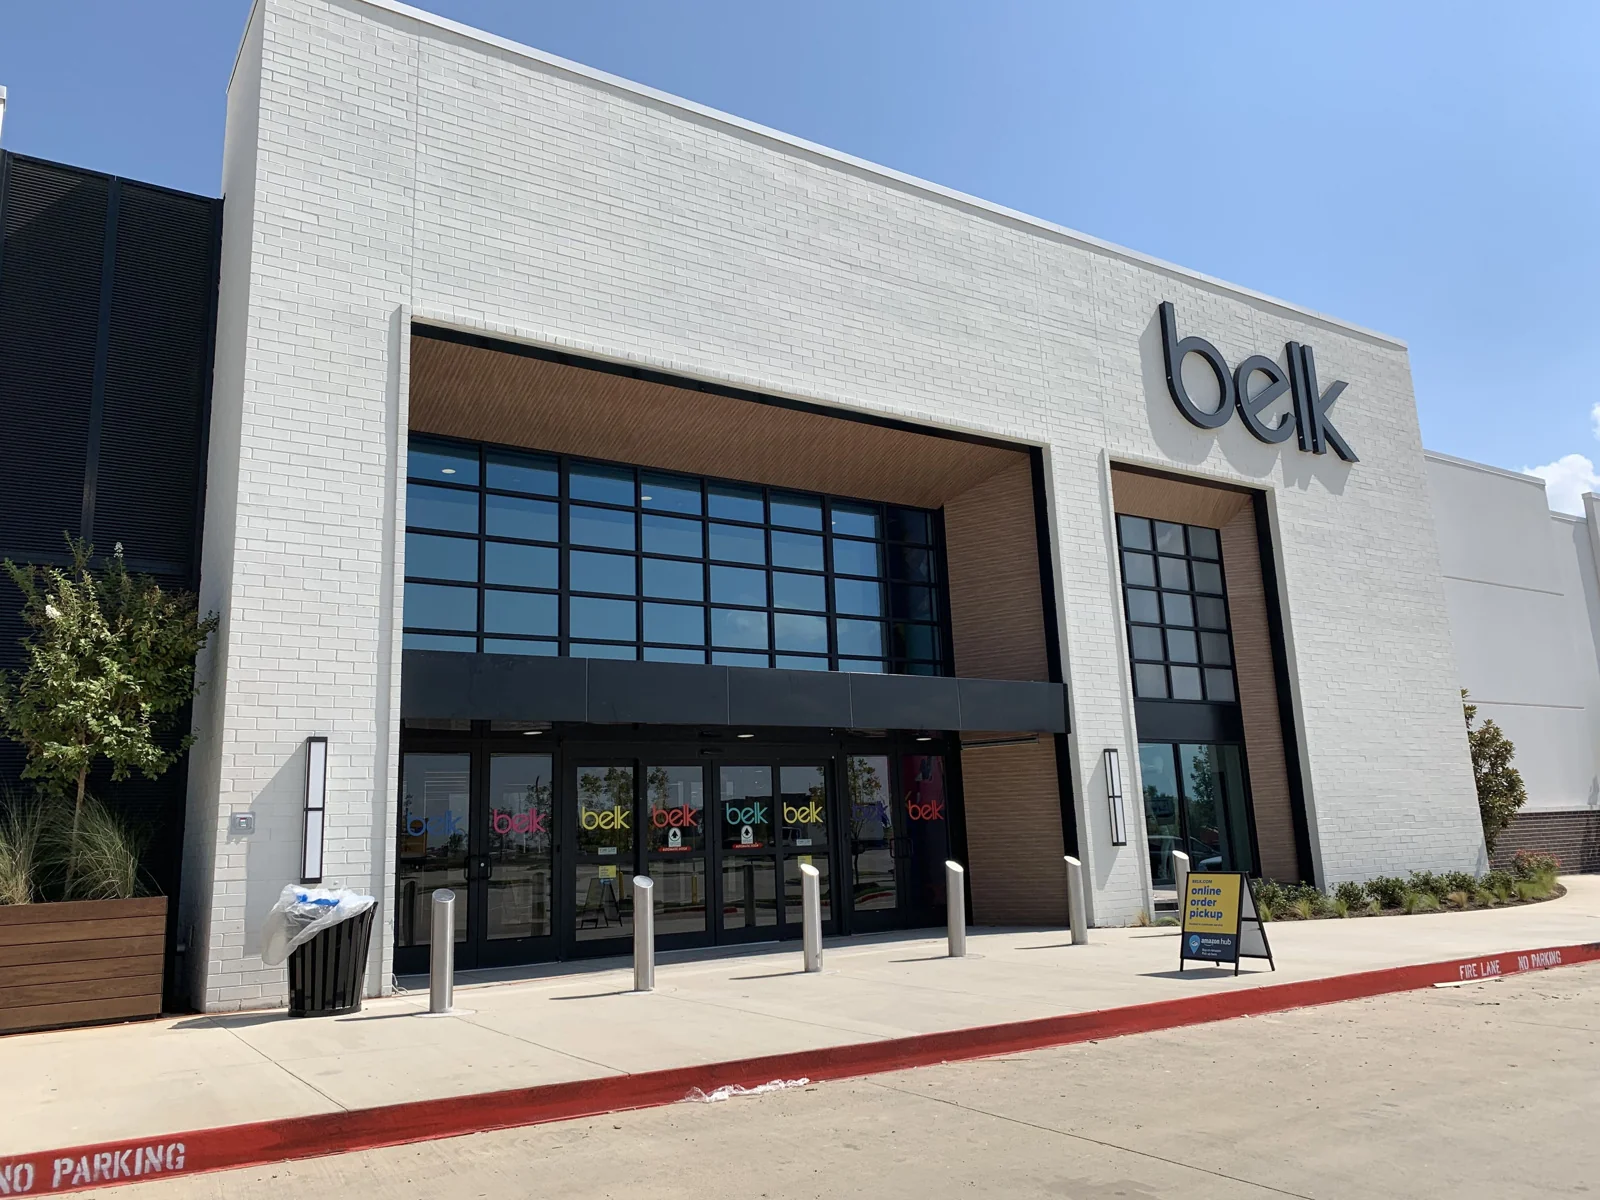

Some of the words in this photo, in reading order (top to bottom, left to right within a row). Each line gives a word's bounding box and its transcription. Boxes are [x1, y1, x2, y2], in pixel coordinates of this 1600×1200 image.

[1159, 301, 1360, 462] belk
[493, 807, 547, 834] belk
[582, 805, 630, 830] belk
[652, 803, 698, 828] belk
[726, 801, 768, 825] belk
[783, 801, 823, 823] belk
[908, 800, 945, 821] belk
[1190, 897, 1217, 907] order
[1191, 885, 1221, 895] online
[1189, 908, 1223, 921] pickup
[1220, 937, 1232, 946] hub
[1459, 963, 1478, 980] FIRE
[1480, 959, 1502, 977] LANE
[1518, 955, 1529, 971] NO
[1531, 950, 1562, 967] PARKING
[52, 1142, 186, 1188] PARKING
